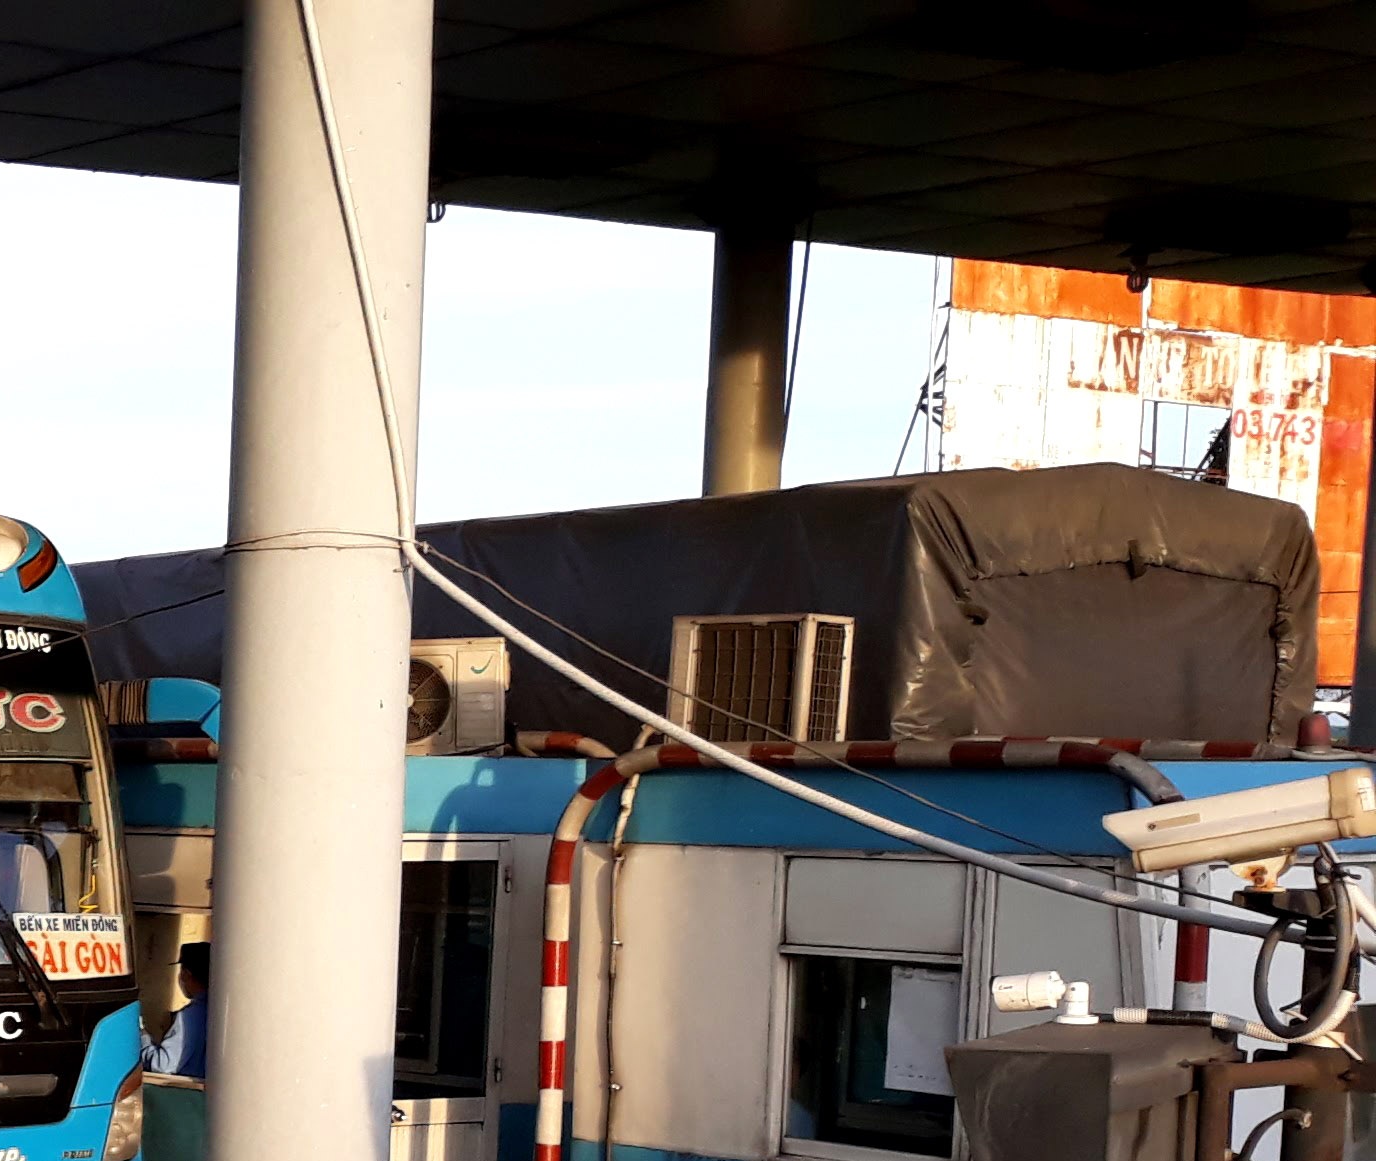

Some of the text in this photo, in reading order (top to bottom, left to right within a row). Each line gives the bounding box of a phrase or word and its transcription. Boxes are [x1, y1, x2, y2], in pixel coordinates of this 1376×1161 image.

[5, 625, 52, 653] ĐÔNG
[45, 917, 60, 931] XE
[26, 932, 123, 974] SÀI GÒN
